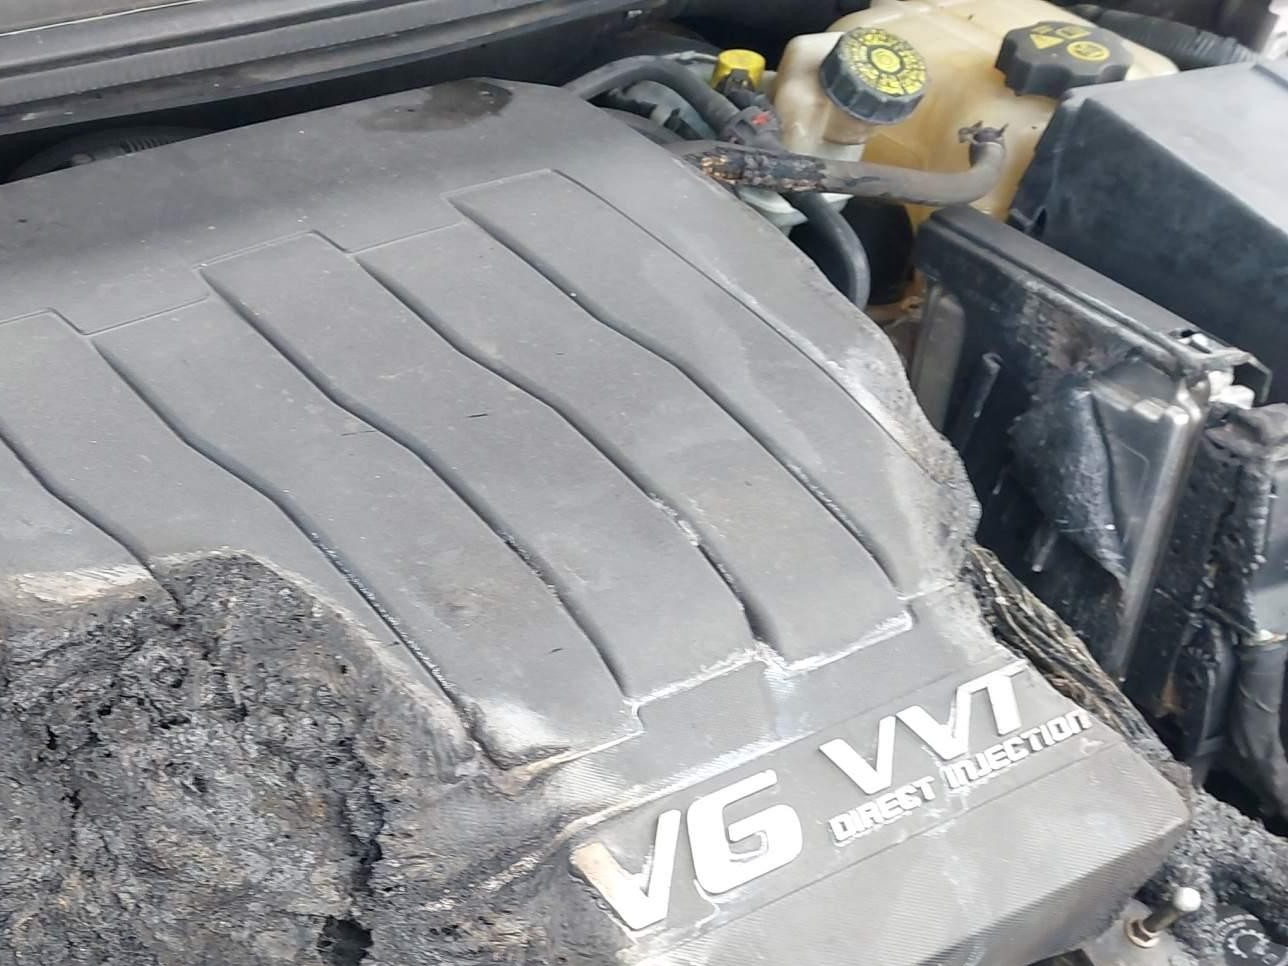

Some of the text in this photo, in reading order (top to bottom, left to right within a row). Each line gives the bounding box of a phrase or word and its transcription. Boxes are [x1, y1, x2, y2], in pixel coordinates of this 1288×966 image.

[571, 659, 1028, 930] V6 VVT
[828, 709, 1092, 842] DIRECT INJECTION
